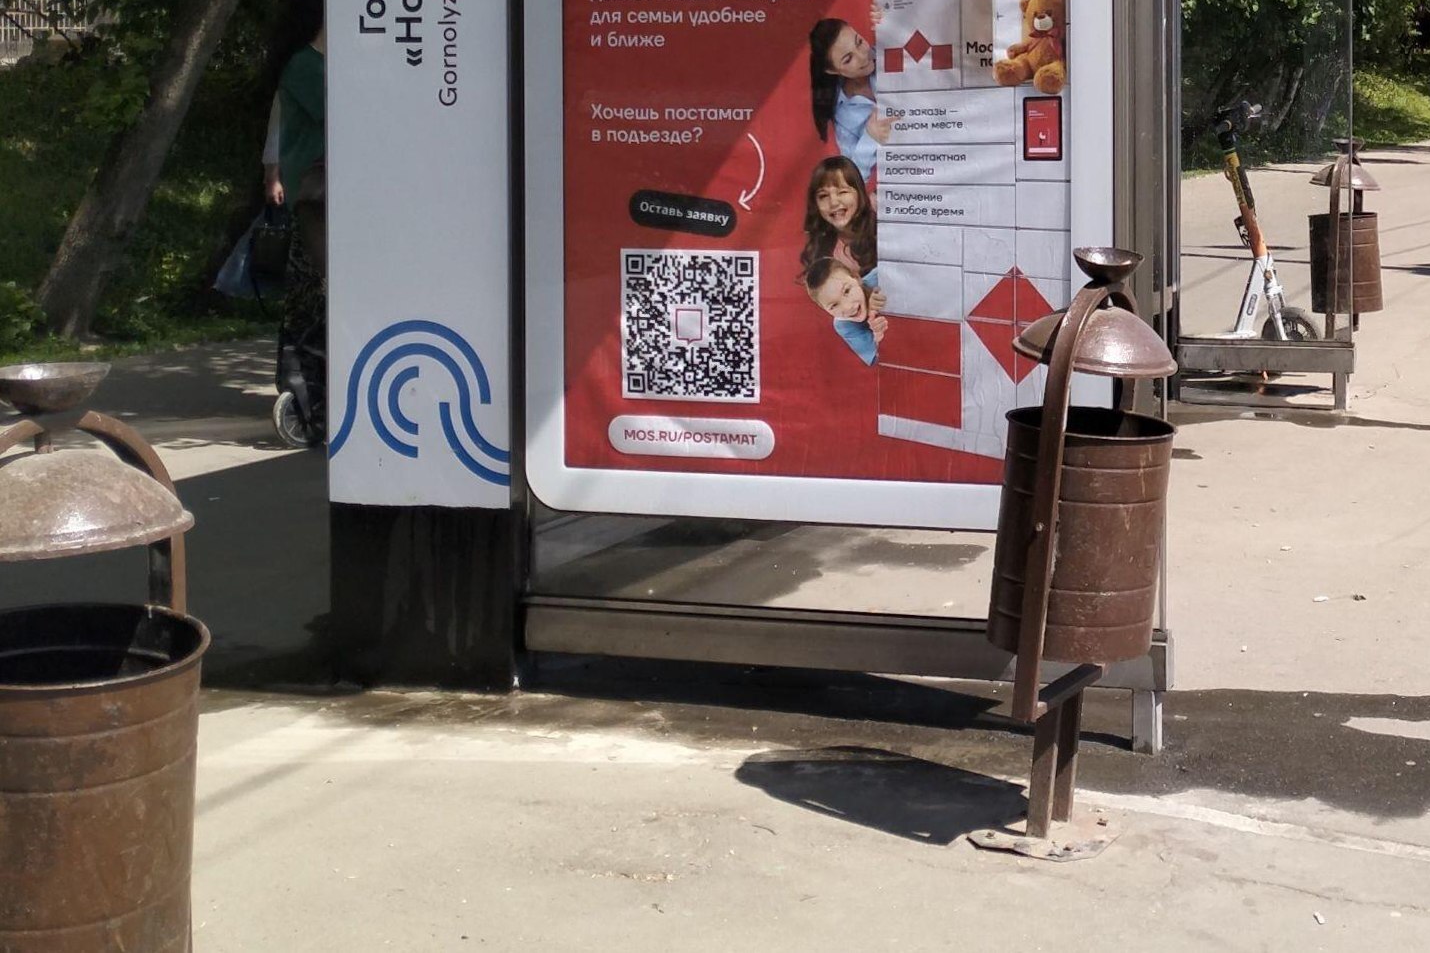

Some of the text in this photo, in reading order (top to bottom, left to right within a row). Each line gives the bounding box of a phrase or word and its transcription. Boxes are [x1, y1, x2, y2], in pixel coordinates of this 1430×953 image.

[591, 7, 766, 26] для семьи удобнее
[591, 31, 665, 46] и ближе
[592, 103, 753, 120] Хочешь постамат
[886, 107, 906, 117] Все
[908, 108, 947, 117] заказы
[895, 121, 929, 132] одном
[931, 121, 964, 131] месте
[592, 126, 703, 144] в подъезде?
[885, 151, 967, 162] Бесконтактная
[885, 166, 934, 176] доставка
[885, 190, 943, 203] Получение
[640, 202, 729, 226] Оставь заявку
[885, 205, 965, 218] в любое время
[623, 428, 758, 446] MOS.RU/POSTAMAT
